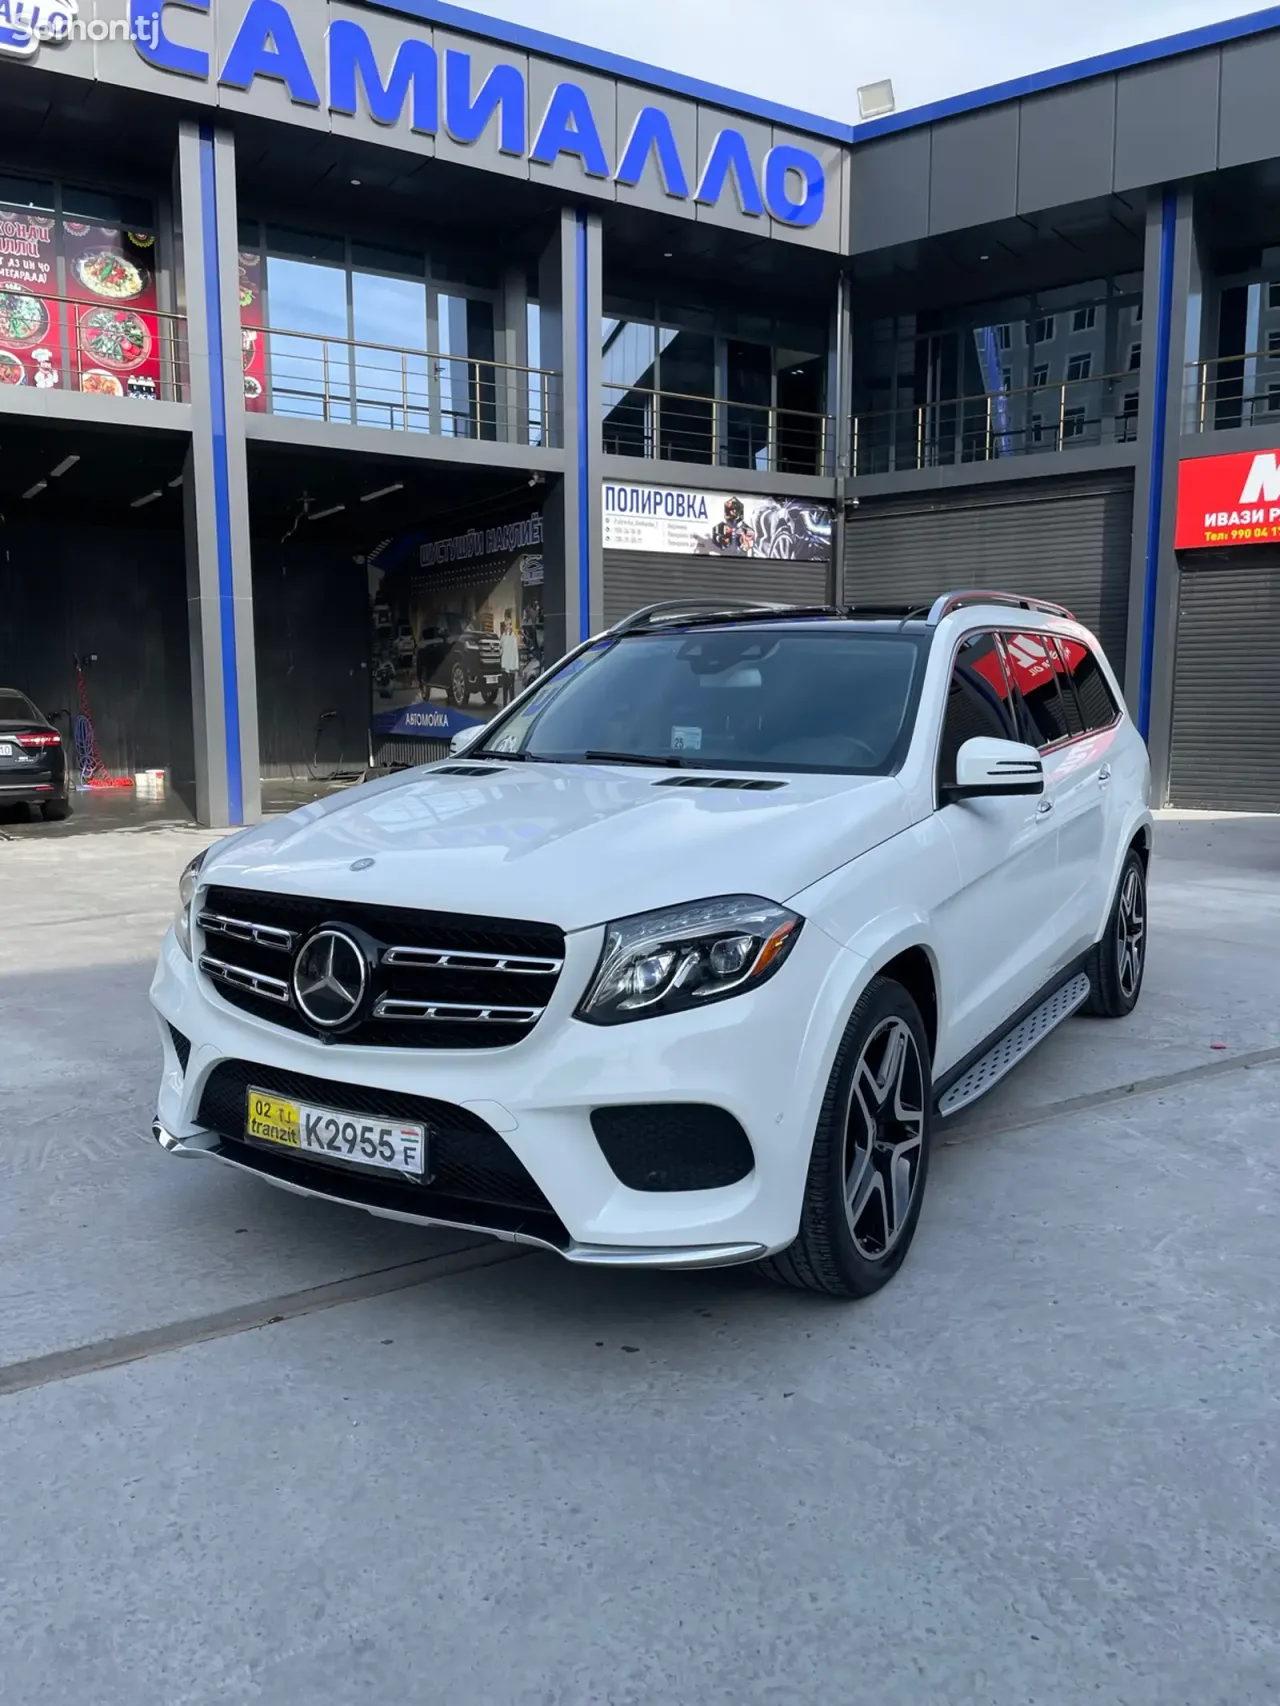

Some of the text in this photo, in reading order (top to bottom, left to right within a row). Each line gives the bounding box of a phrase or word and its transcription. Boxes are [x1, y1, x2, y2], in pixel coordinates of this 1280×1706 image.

[605, 486, 708, 519] ПОЛИРОВКА
[1204, 507, 1280, 528] ИВАЗИ Р
[1204, 531, 1228, 541] Тел:
[1231, 528, 1251, 539] 990
[1254, 527, 1268, 537] 04
[405, 711, 449, 727] АВТОМОЙКА
[255, 1100, 272, 1118] 02
[252, 1117, 298, 1144] tranzit
[305, 1113, 396, 1162] K2955
[403, 1146, 417, 1165] F
